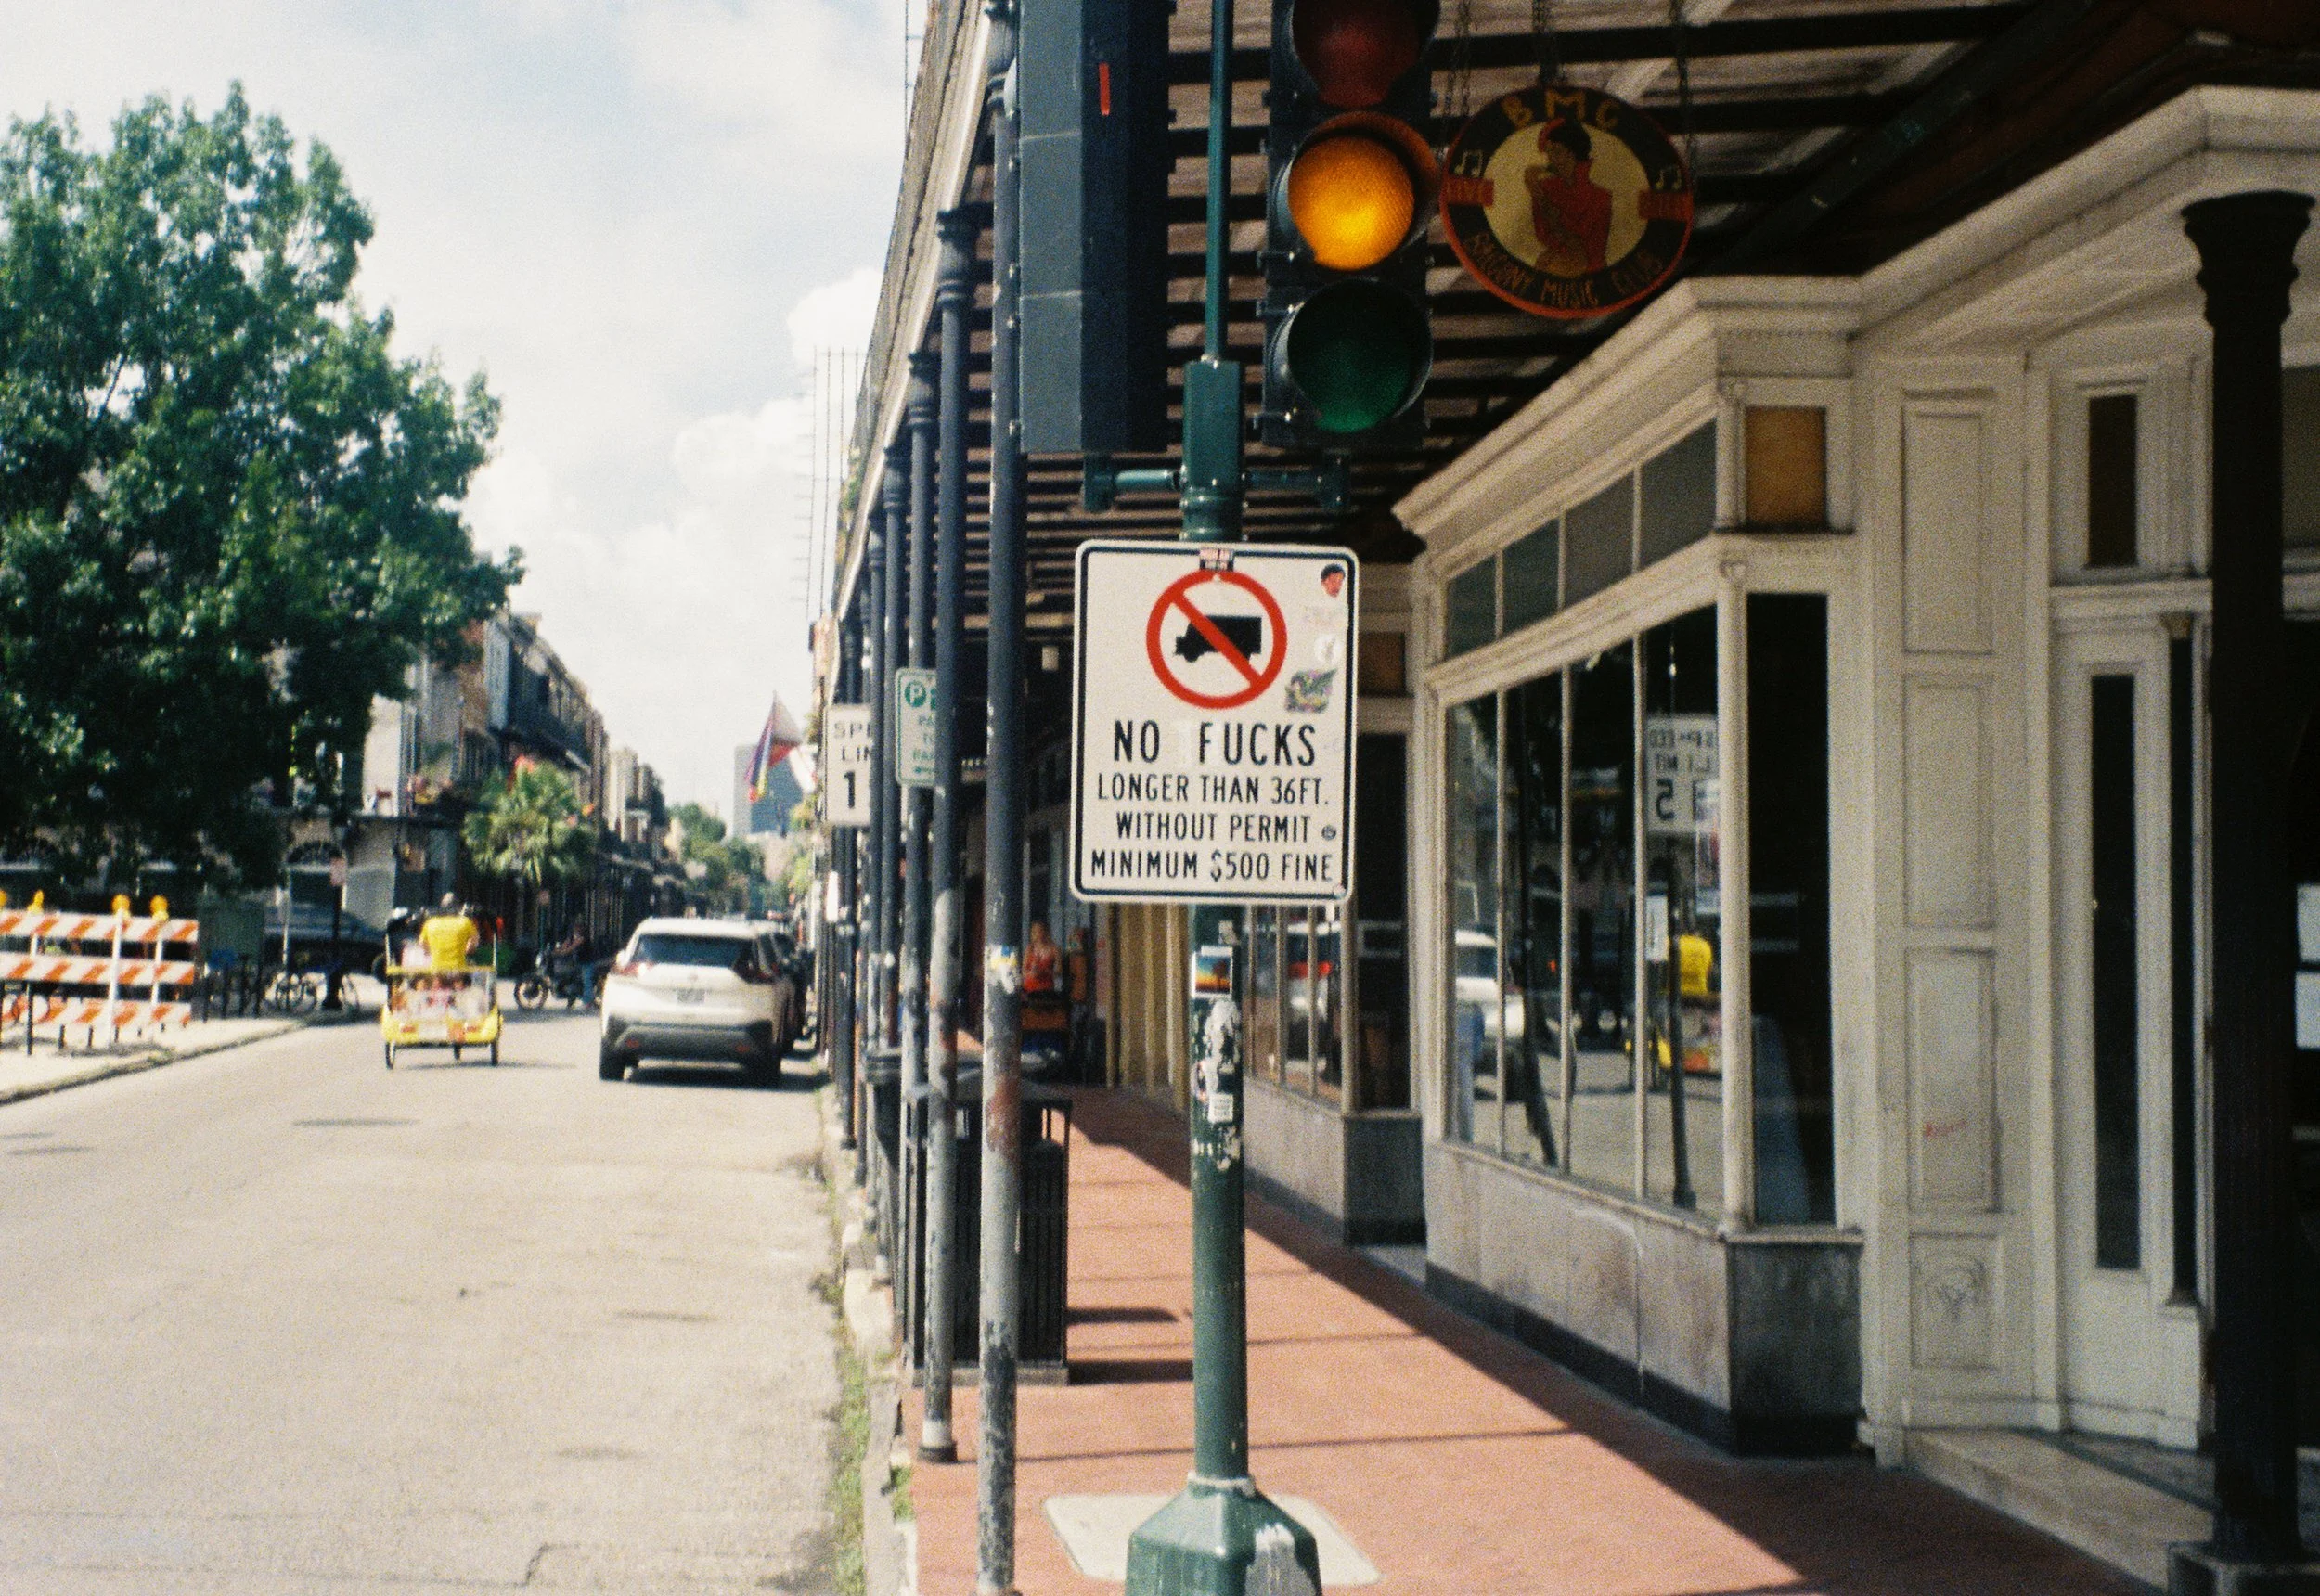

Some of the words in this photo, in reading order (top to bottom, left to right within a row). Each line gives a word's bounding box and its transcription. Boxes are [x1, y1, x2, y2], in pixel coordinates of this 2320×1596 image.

[1500, 88, 1621, 130] BMC
[1540, 277, 1600, 309] MUSIC
[1113, 719, 1161, 764] NO
[1198, 721, 1316, 767] FUCKS
[1097, 772, 1190, 803] LONGER
[1199, 774, 1259, 804] THAN
[1270, 776, 1330, 806] 36FT.
[1115, 811, 1218, 842] WITHOUT
[1229, 813, 1311, 843] PERMIT
[1090, 848, 1199, 879] MINIMUM
[1210, 848, 1270, 883] $500
[1282, 852, 1334, 882] FINE
